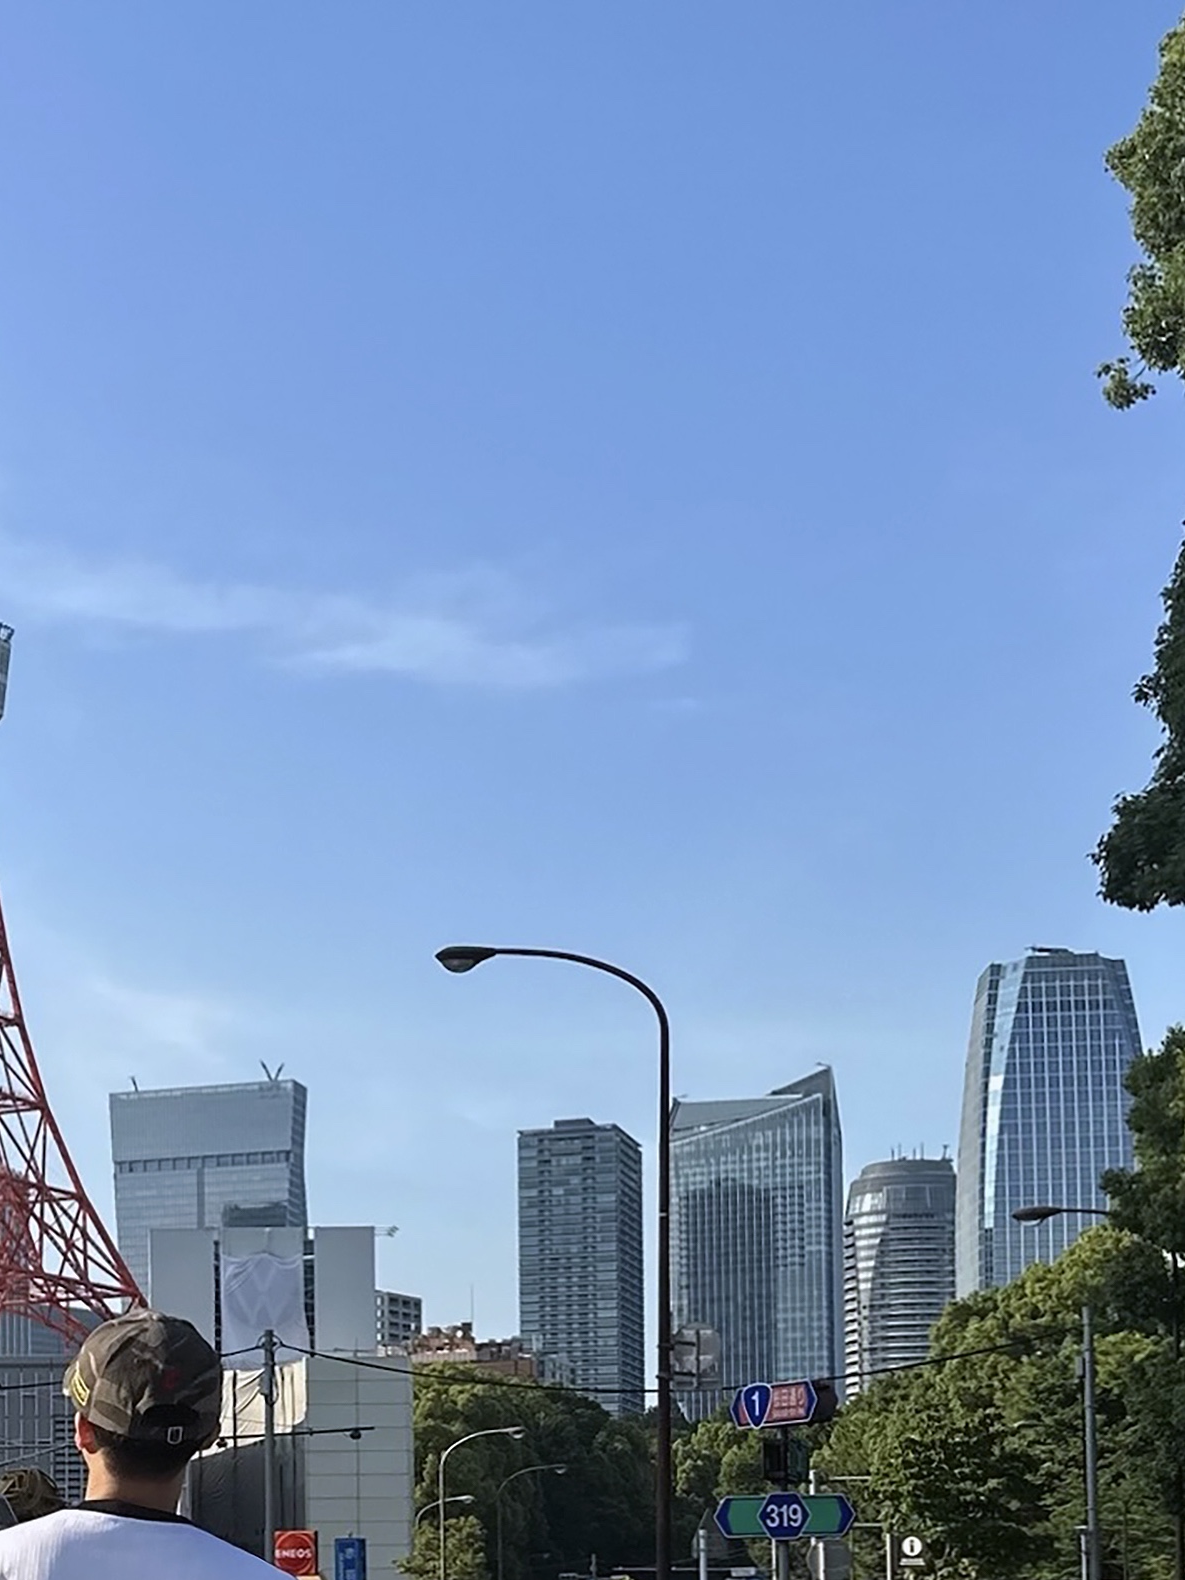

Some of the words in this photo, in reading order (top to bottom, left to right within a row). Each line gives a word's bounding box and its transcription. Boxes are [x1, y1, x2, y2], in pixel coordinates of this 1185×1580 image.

[751, 1390, 760, 1417] 1
[765, 1503, 803, 1528] 319
[274, 1547, 312, 1559] ENEOS
